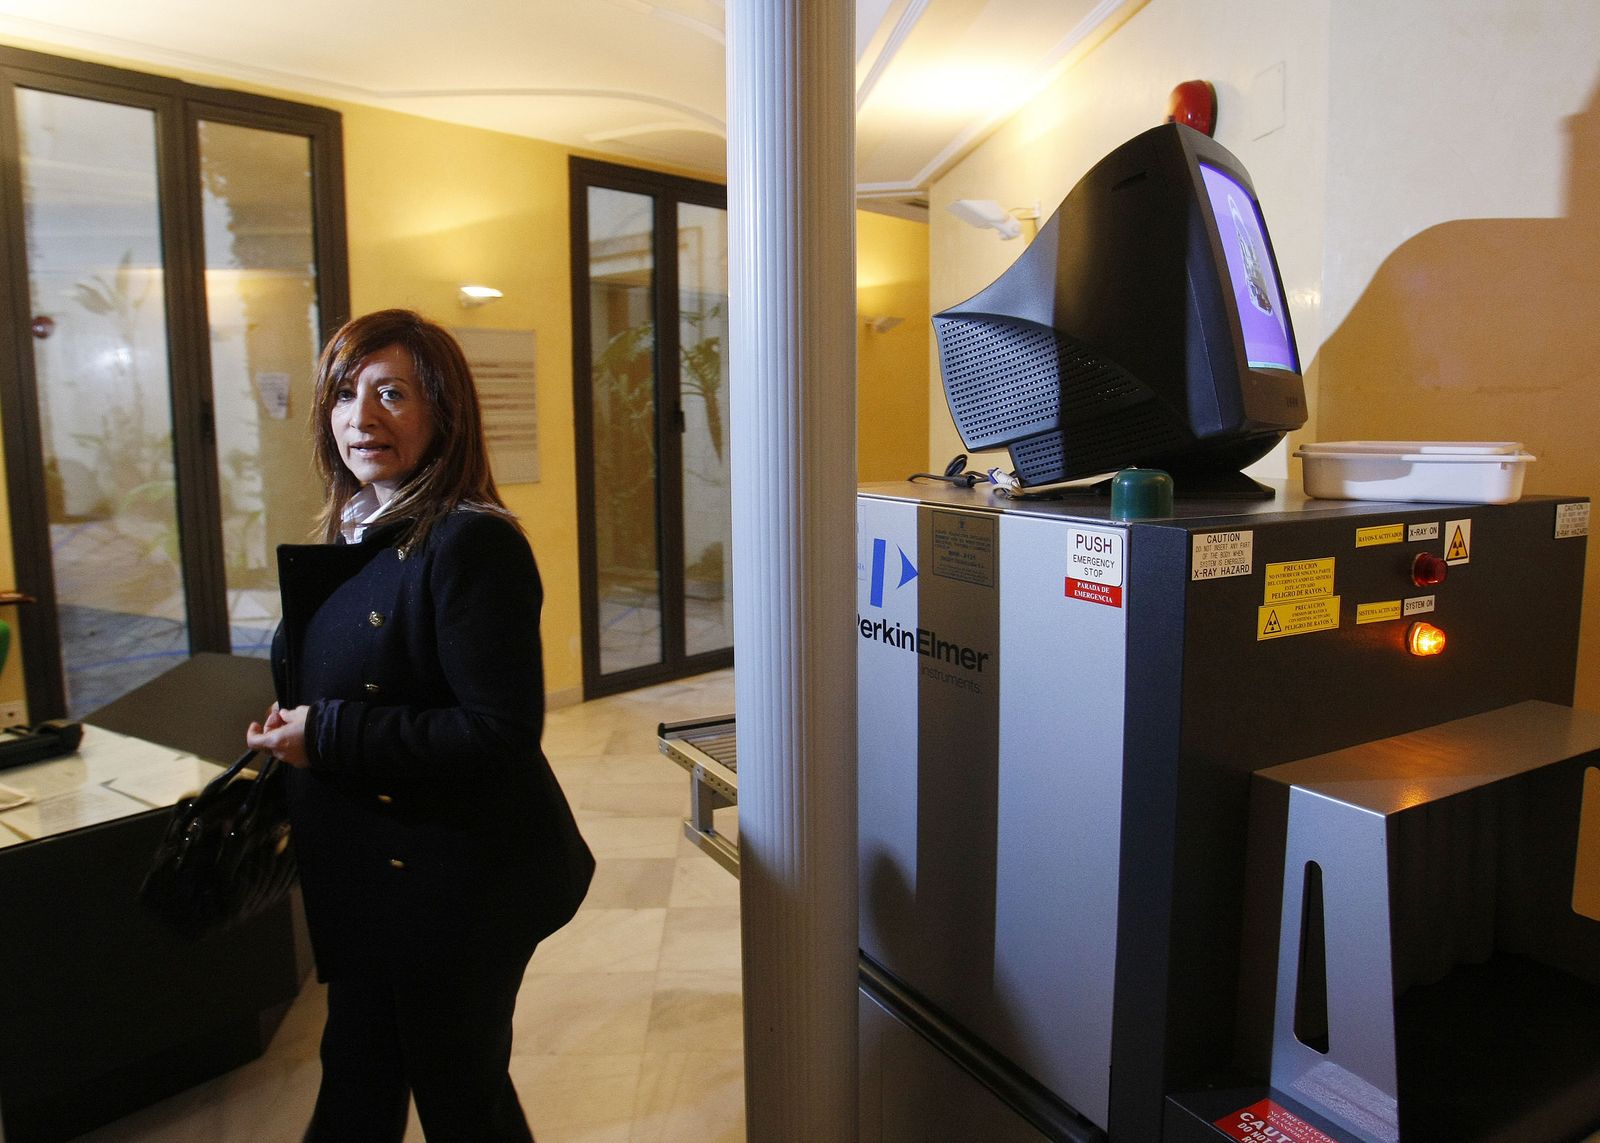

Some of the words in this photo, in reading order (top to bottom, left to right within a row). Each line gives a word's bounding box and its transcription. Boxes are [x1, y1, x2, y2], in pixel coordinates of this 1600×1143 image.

[1410, 528, 1427, 537] X-RAY
[1429, 526, 1438, 534] ON
[1076, 534, 1112, 554] PUSH
[1206, 532, 1240, 544] CAUTION
[1072, 554, 1114, 568] EMERGENCY
[1084, 567, 1104, 578] STOP
[1194, 568, 1218, 578] X-RAY
[1220, 564, 1250, 576] HAZARD
[1077, 582, 1100, 592] PARADA
[1074, 590, 1112, 603] EMERGENCIA
[1272, 590, 1296, 600] PELIGRO
[1406, 601, 1425, 610] SYSTEM
[858, 614, 989, 672] erkinElmer
[1236, 1122, 1252, 1132] DO
[1250, 1131, 1272, 1143] NOT
